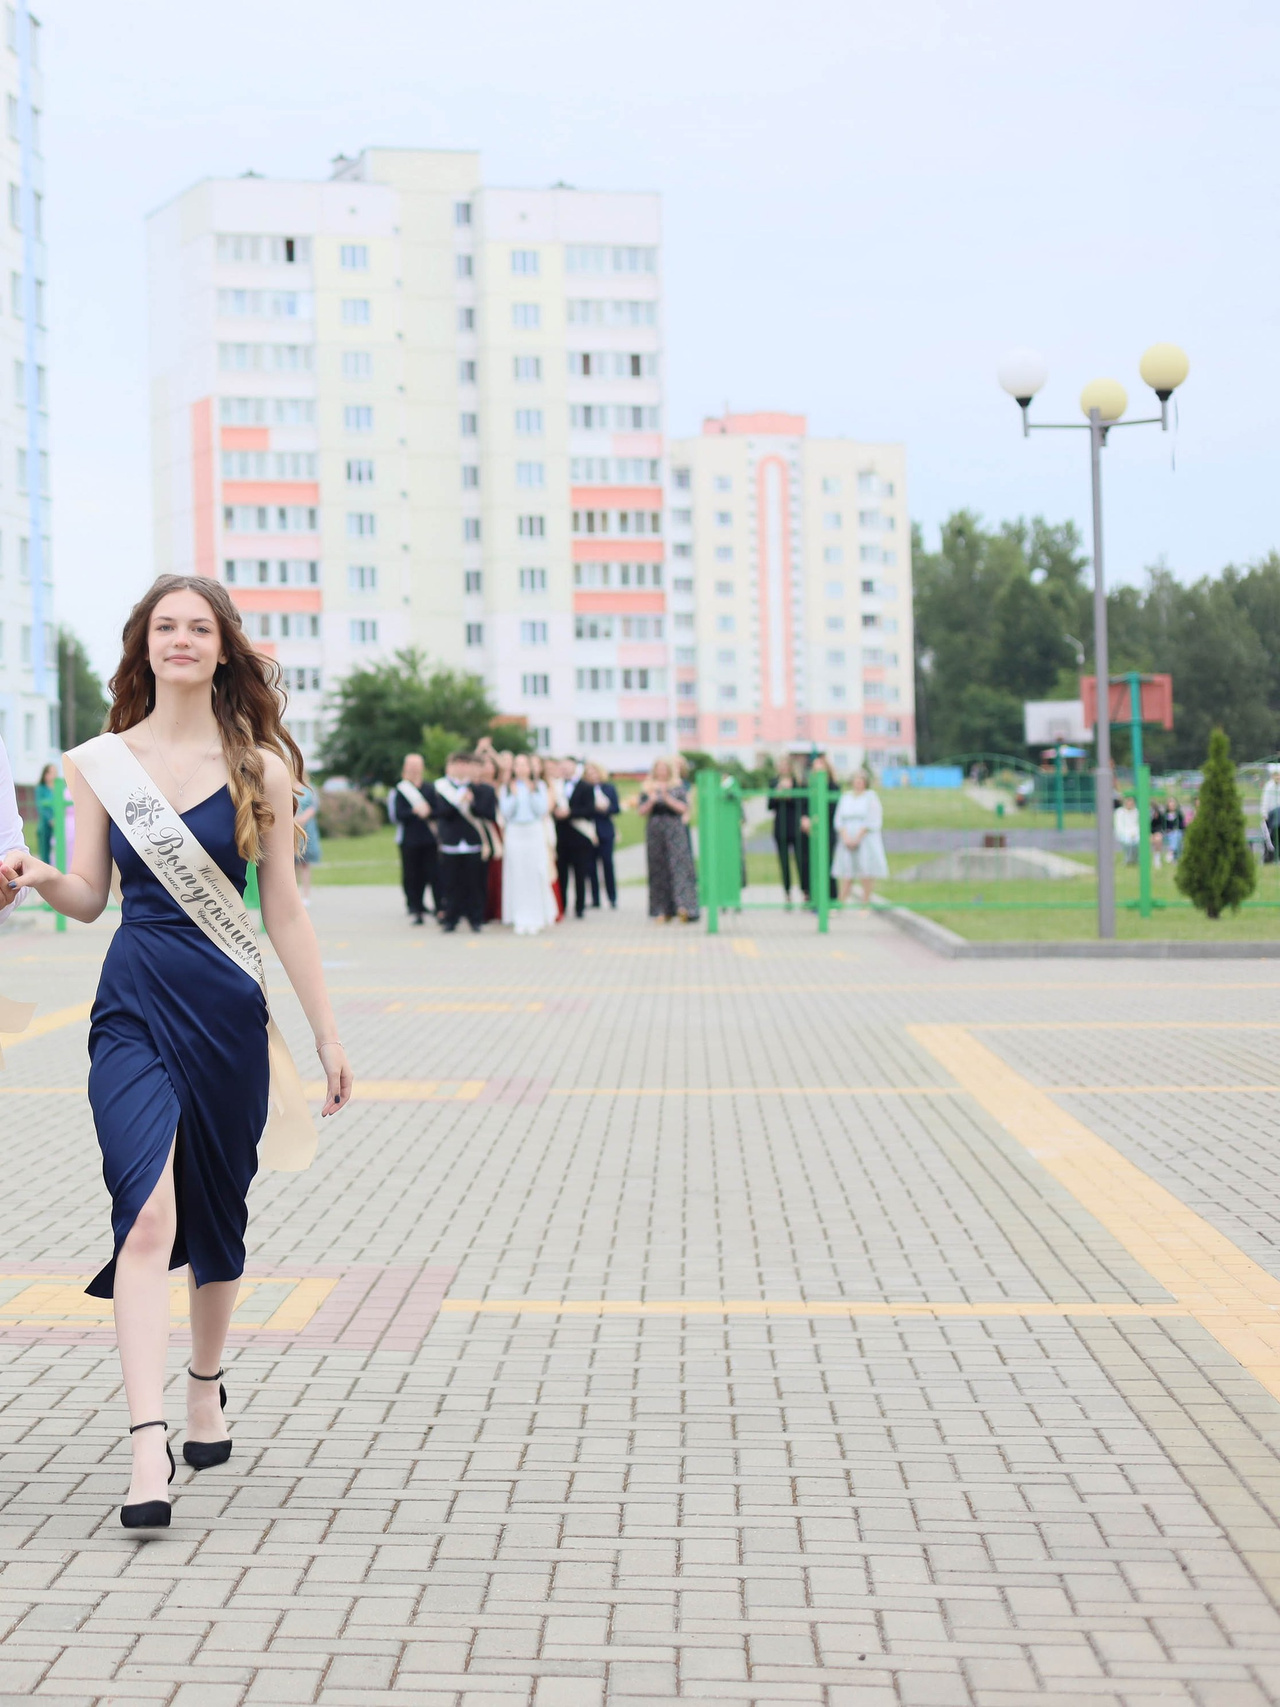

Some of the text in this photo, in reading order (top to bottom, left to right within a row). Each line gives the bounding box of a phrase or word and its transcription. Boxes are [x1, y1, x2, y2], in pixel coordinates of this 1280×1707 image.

[146, 826, 262, 967] Выпускница
[162, 871, 180, 891] класс
[197, 907, 218, 933] Средняя
[217, 932, 232, 949] школа
